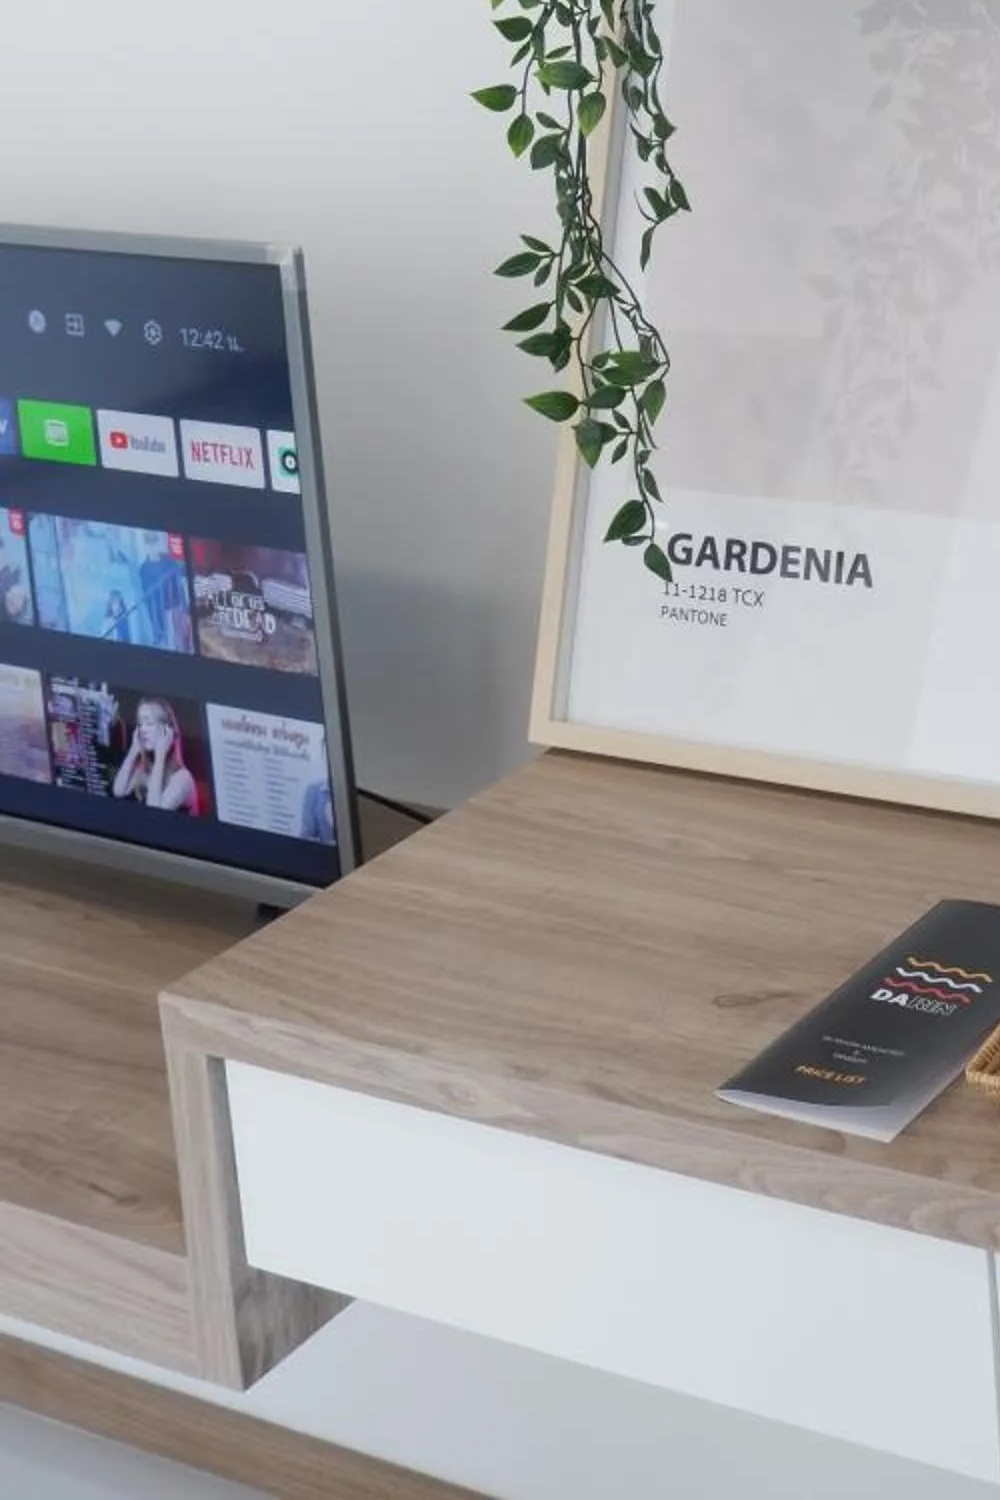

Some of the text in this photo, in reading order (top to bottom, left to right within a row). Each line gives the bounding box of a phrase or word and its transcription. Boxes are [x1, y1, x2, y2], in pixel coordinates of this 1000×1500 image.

[191, 439, 255, 470] NETFLIX
[666, 532, 873, 588] GARDENIA
[732, 587, 765, 607] TCX
[660, 605, 729, 627] PANTONE
